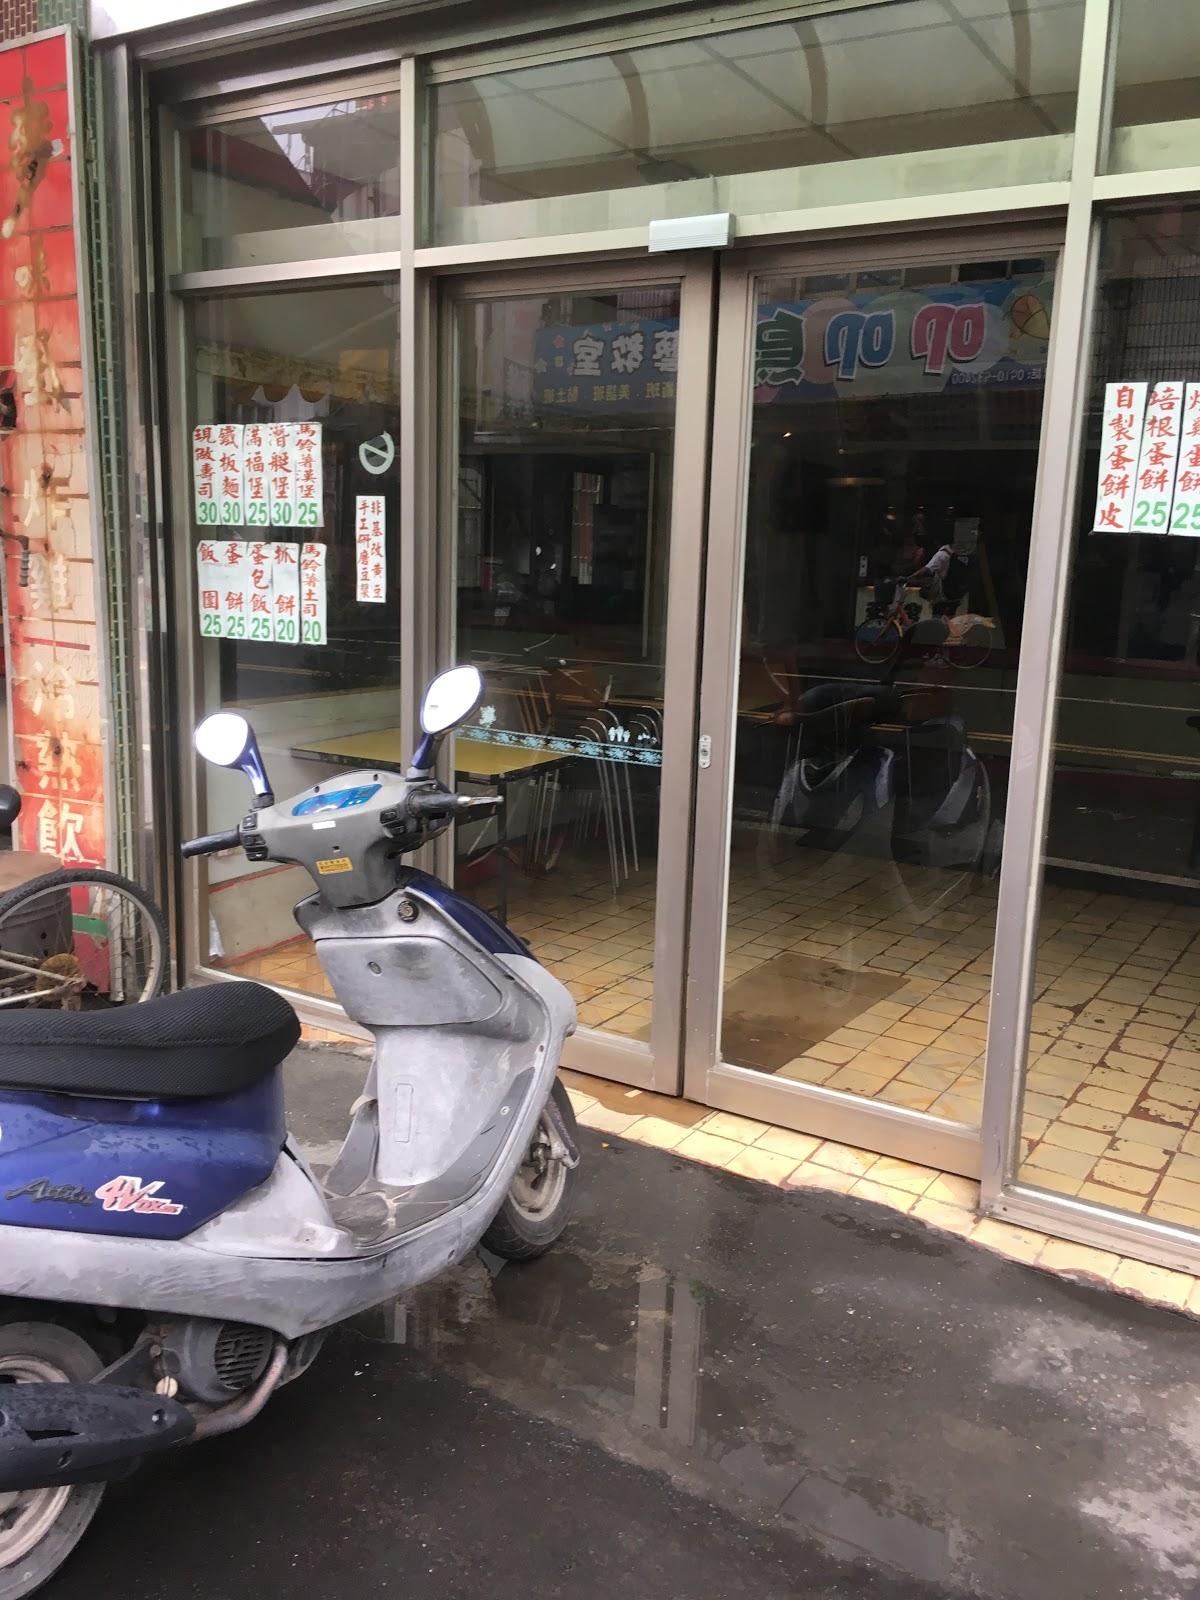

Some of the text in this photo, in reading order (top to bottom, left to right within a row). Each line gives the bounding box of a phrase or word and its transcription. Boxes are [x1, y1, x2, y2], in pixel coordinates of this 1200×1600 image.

[194, 426, 217, 523] 現做壽司 30
[219, 425, 240, 523] 鐵板麵 30
[246, 425, 268, 524] 滿福堡 25
[268, 425, 292, 524] 潛艇堡 30
[296, 423, 318, 525] 馬鈴薯漢堡 25
[1098, 385, 1136, 530] 自製蛋餅皮
[1134, 386, 1180, 528] 培根蛋餅 25
[203, 614, 222, 635] 25
[225, 543, 245, 637] 蛋餅 25
[250, 543, 271, 639] 蛋包飯 25
[275, 545, 296, 641] 抓餅 20
[301, 544, 321, 642] 馬鈴薯土司 20
